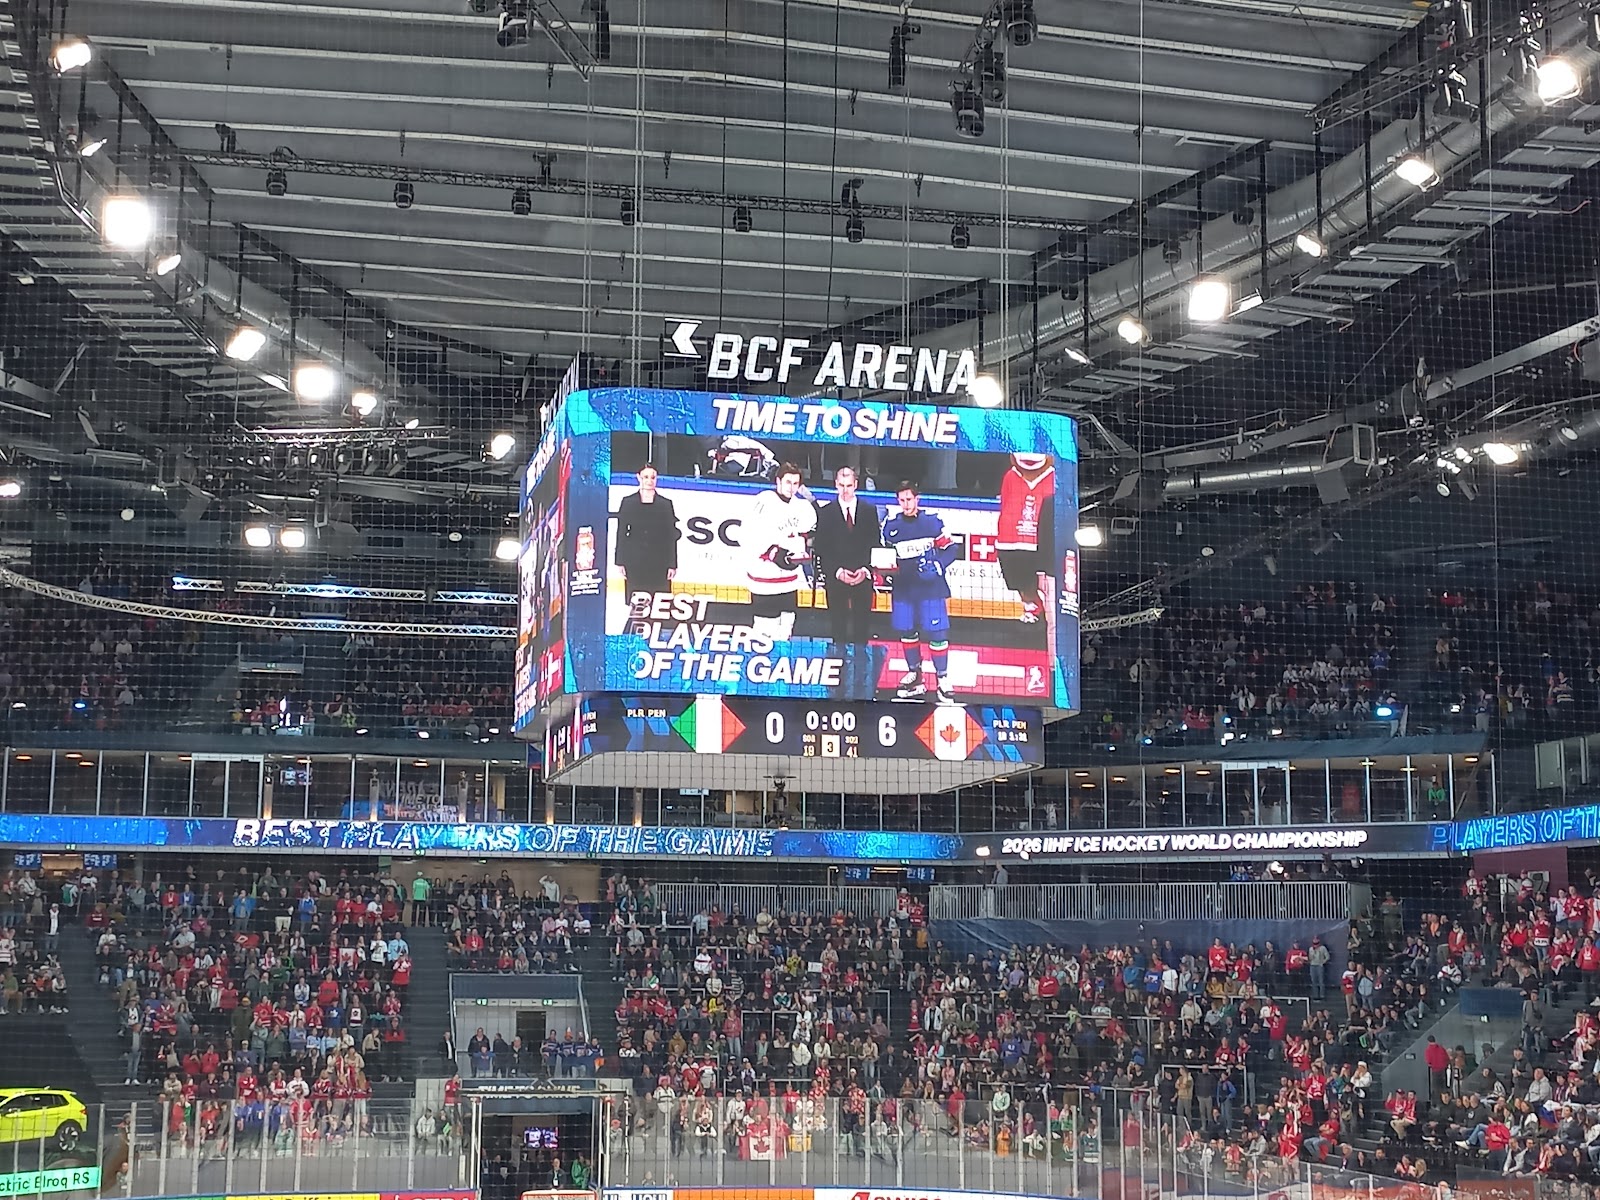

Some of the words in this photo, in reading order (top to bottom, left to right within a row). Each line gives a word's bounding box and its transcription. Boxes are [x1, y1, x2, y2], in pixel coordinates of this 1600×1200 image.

[707, 333, 810, 384] BCF
[814, 341, 979, 395] ARENA
[712, 398, 800, 433] TIME
[802, 403, 852, 437] TO
[853, 408, 960, 445] SHINE
[629, 591, 714, 622] BEST
[630, 620, 774, 654] PLAYERS
[628, 650, 678, 680] OF
[679, 653, 744, 683] THE
[746, 656, 843, 686] GAME
[647, 709, 666, 718] PEN
[765, 711, 784, 744] 0
[806, 711, 856, 731] 0:00
[827, 741, 834, 753] 3
[878, 715, 897, 747] 6
[846, 746, 858, 758] 41
[233, 819, 339, 849] BEST
[340, 820, 520, 852] PLAYERS
[524, 823, 579, 853] OF
[586, 825, 661, 855] THE
[665, 827, 775, 856] GAME
[1001, 837, 1042, 854] 2026
[1074, 836, 1102, 853] ICE
[1102, 835, 1171, 852] HOCKEY
[1171, 833, 1232, 850] WORLD
[1233, 830, 1367, 849] CHAMPIONSHIP
[1432, 813, 1537, 851] PLAYERS
[1539, 808, 1574, 842] OF
[34, 1174, 68, 1189] Elroq
[73, 1172, 90, 1185] RS
